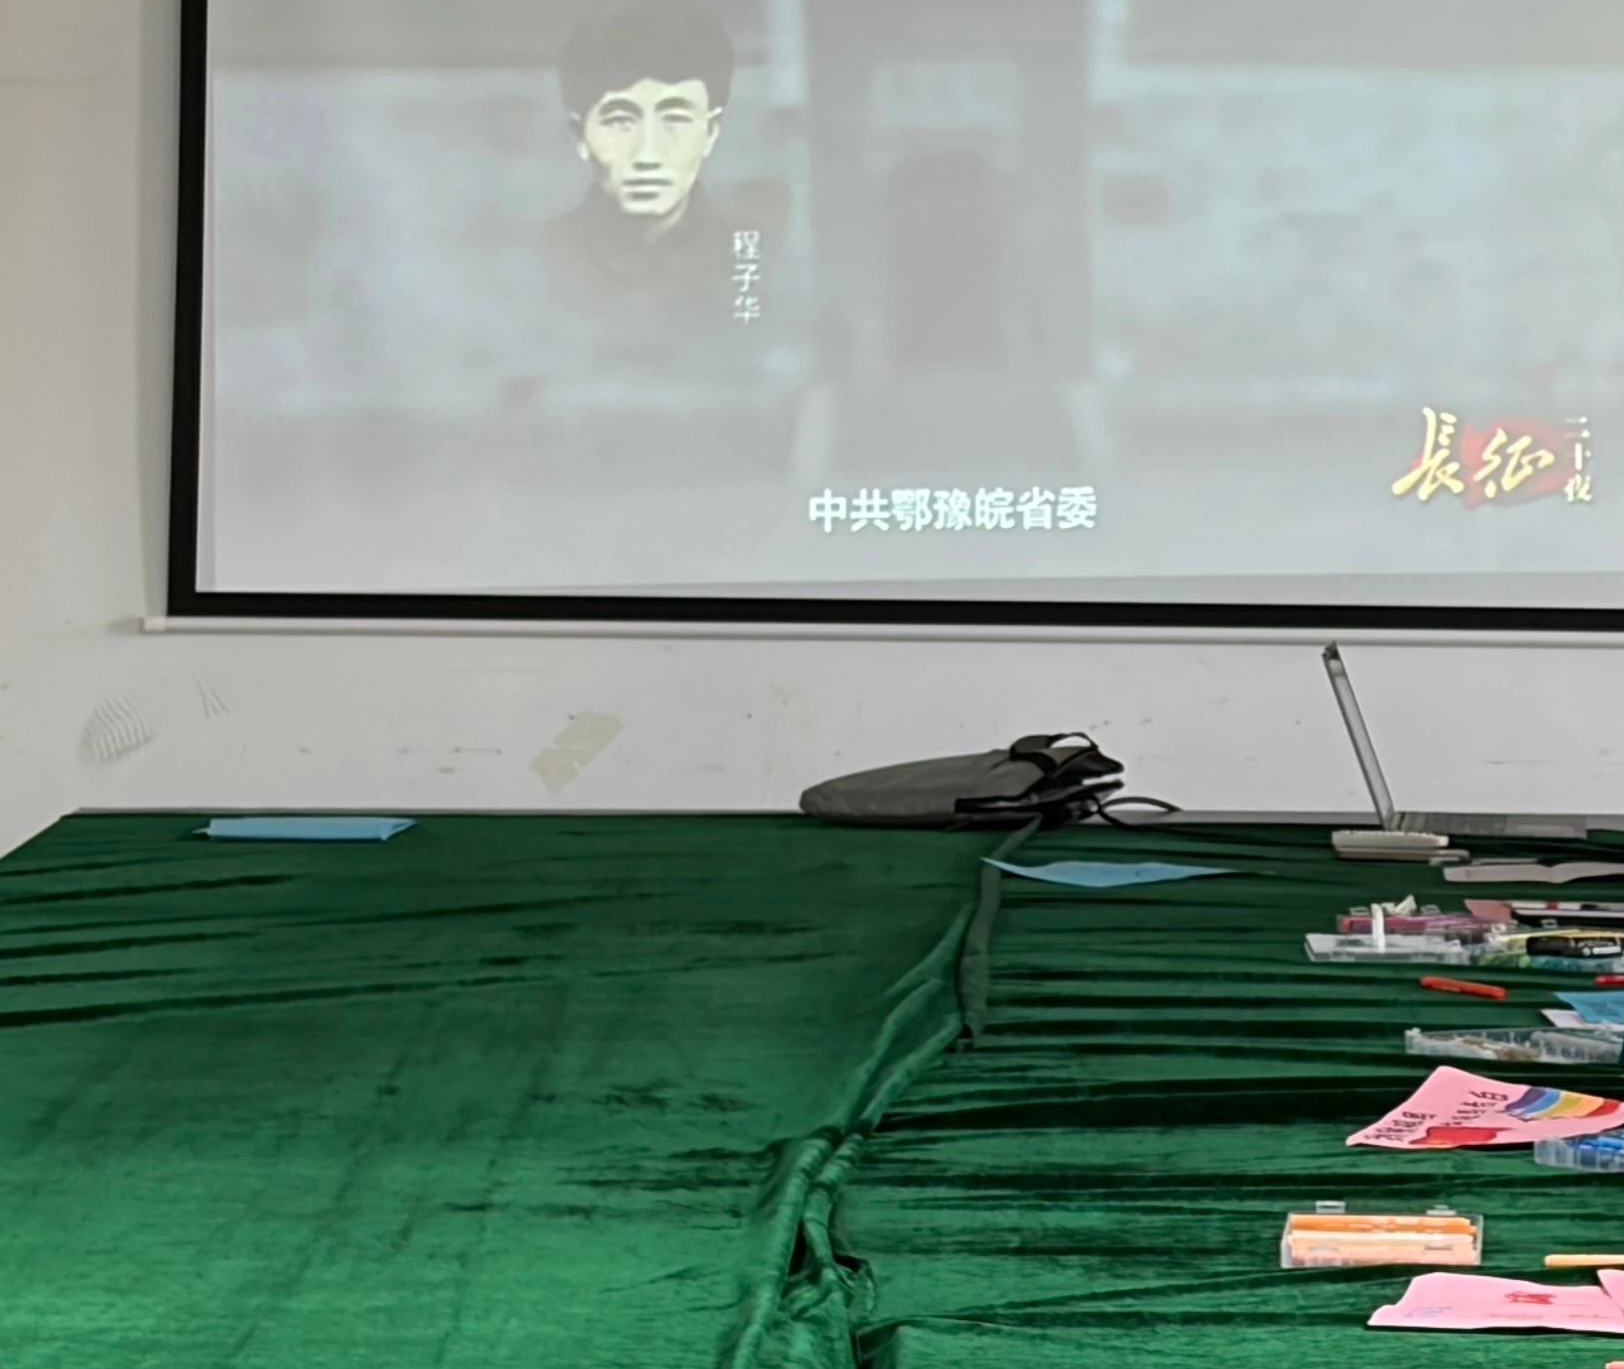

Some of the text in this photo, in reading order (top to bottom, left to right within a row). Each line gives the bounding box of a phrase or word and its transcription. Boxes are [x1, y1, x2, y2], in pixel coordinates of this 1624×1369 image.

[732, 230, 761, 324] 程子华
[808, 486, 1098, 533] 中共鄂豫皖省委
